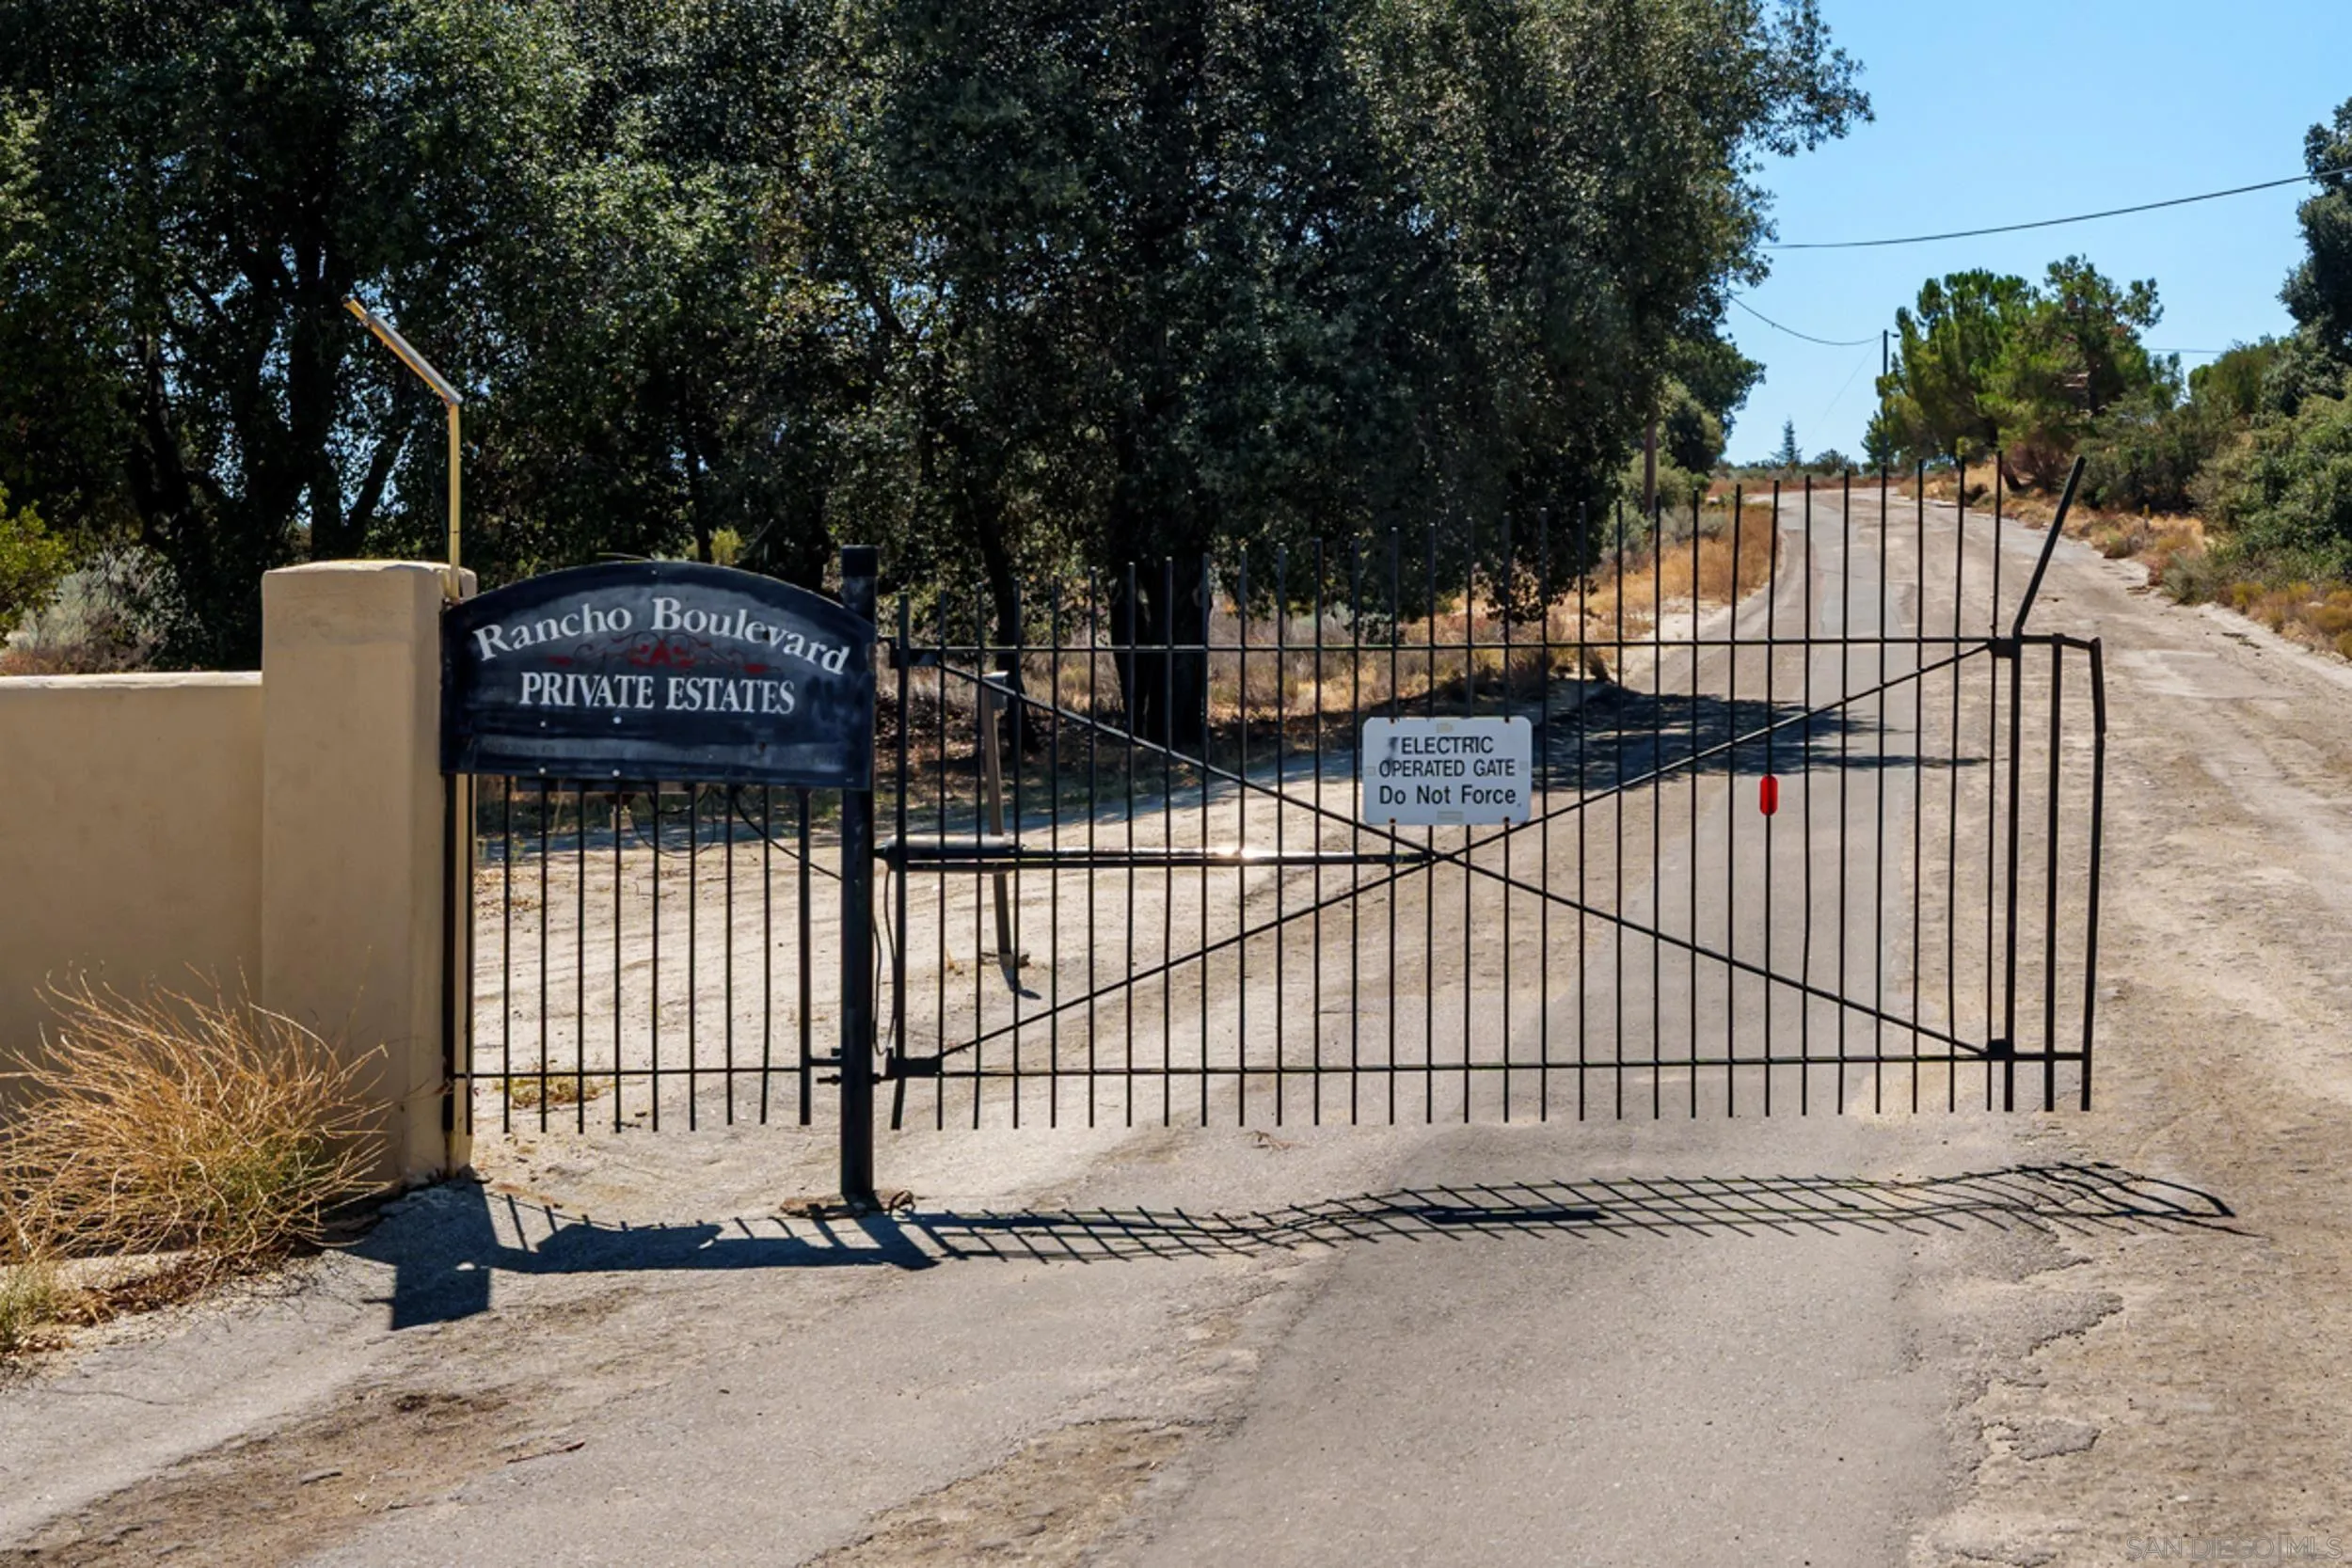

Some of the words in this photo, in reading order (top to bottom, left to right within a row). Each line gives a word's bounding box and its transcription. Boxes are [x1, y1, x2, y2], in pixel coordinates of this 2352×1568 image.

[472, 602, 632, 661] Rancho
[650, 596, 850, 675] Boulevard
[519, 672, 655, 709] PRIVATE
[666, 676, 796, 714] ESTATES
[1401, 736, 1494, 754] ELECTRIC
[1378, 758, 1466, 778] OPERATED
[1473, 758, 1516, 777] GATE
[1379, 785, 1406, 805] Do
[1417, 784, 1451, 805] Not
[1462, 784, 1517, 805] Force
